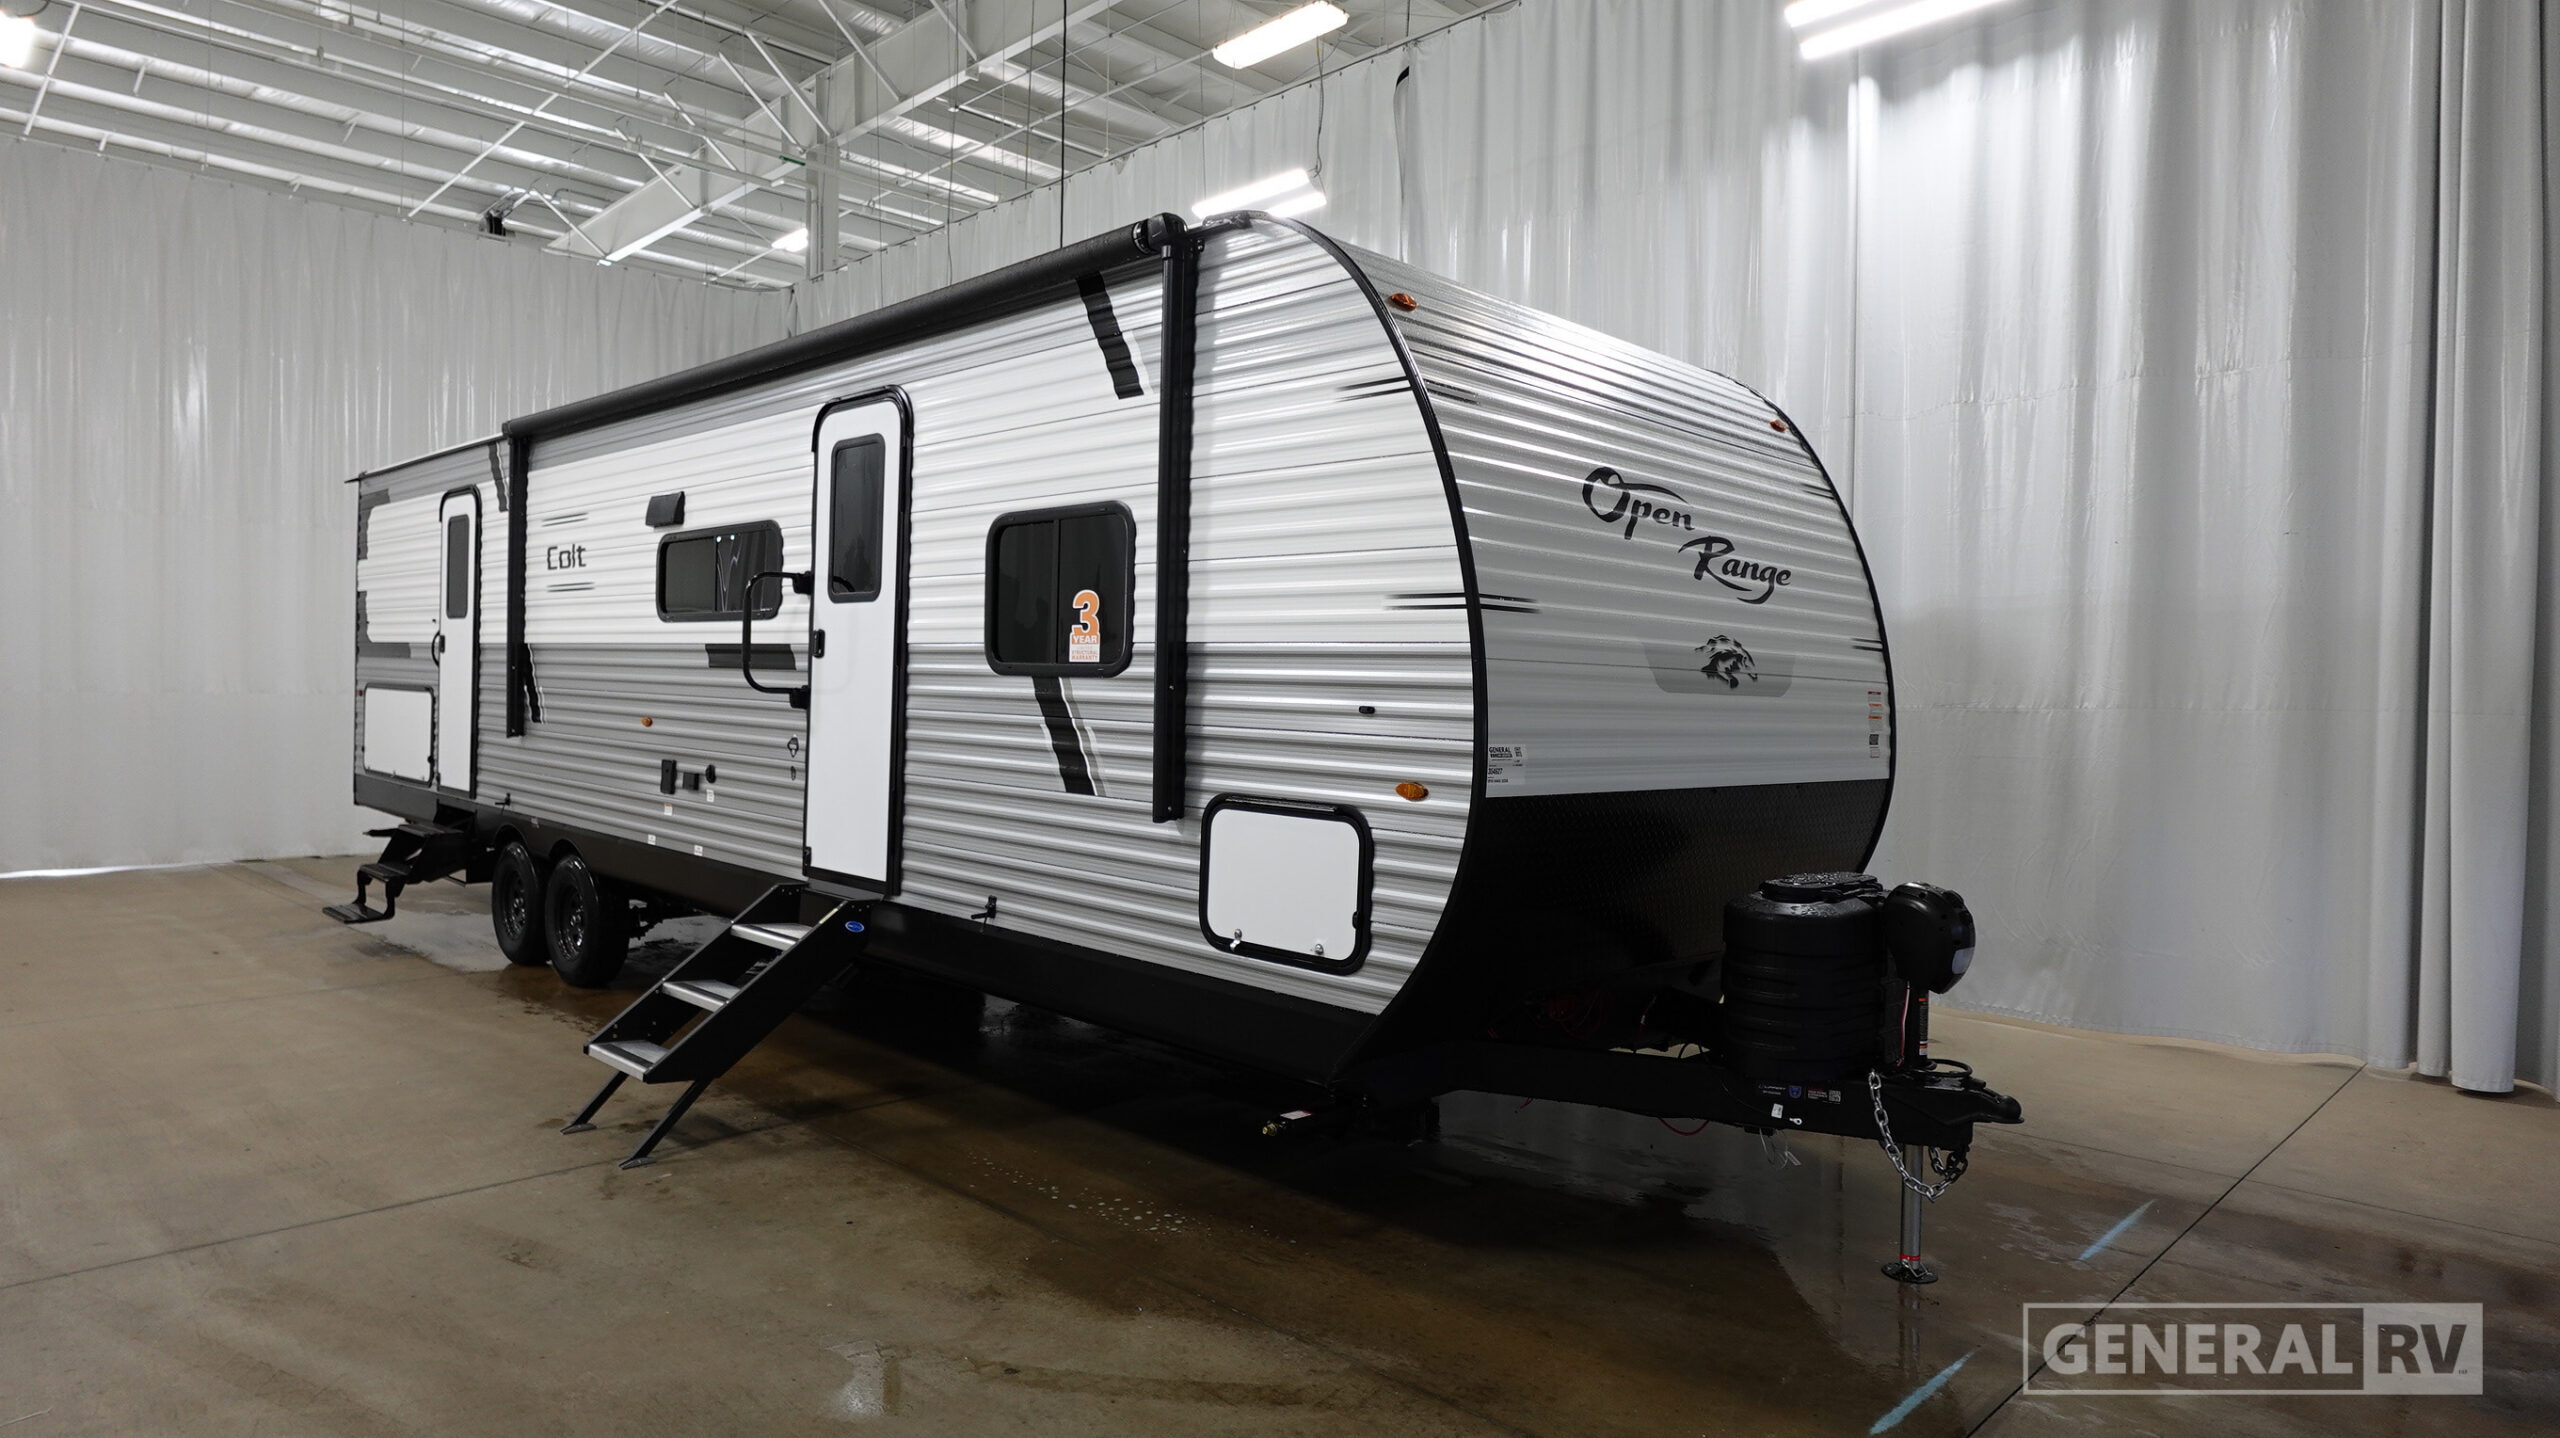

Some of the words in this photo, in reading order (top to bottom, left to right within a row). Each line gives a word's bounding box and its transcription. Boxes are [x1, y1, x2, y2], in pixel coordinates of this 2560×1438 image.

[1582, 466, 1695, 540] Open
[547, 544, 586, 570] Colt
[1677, 536, 1792, 605] Range
[1072, 589, 1099, 635] 3
[1073, 635, 1097, 644] YEAR
